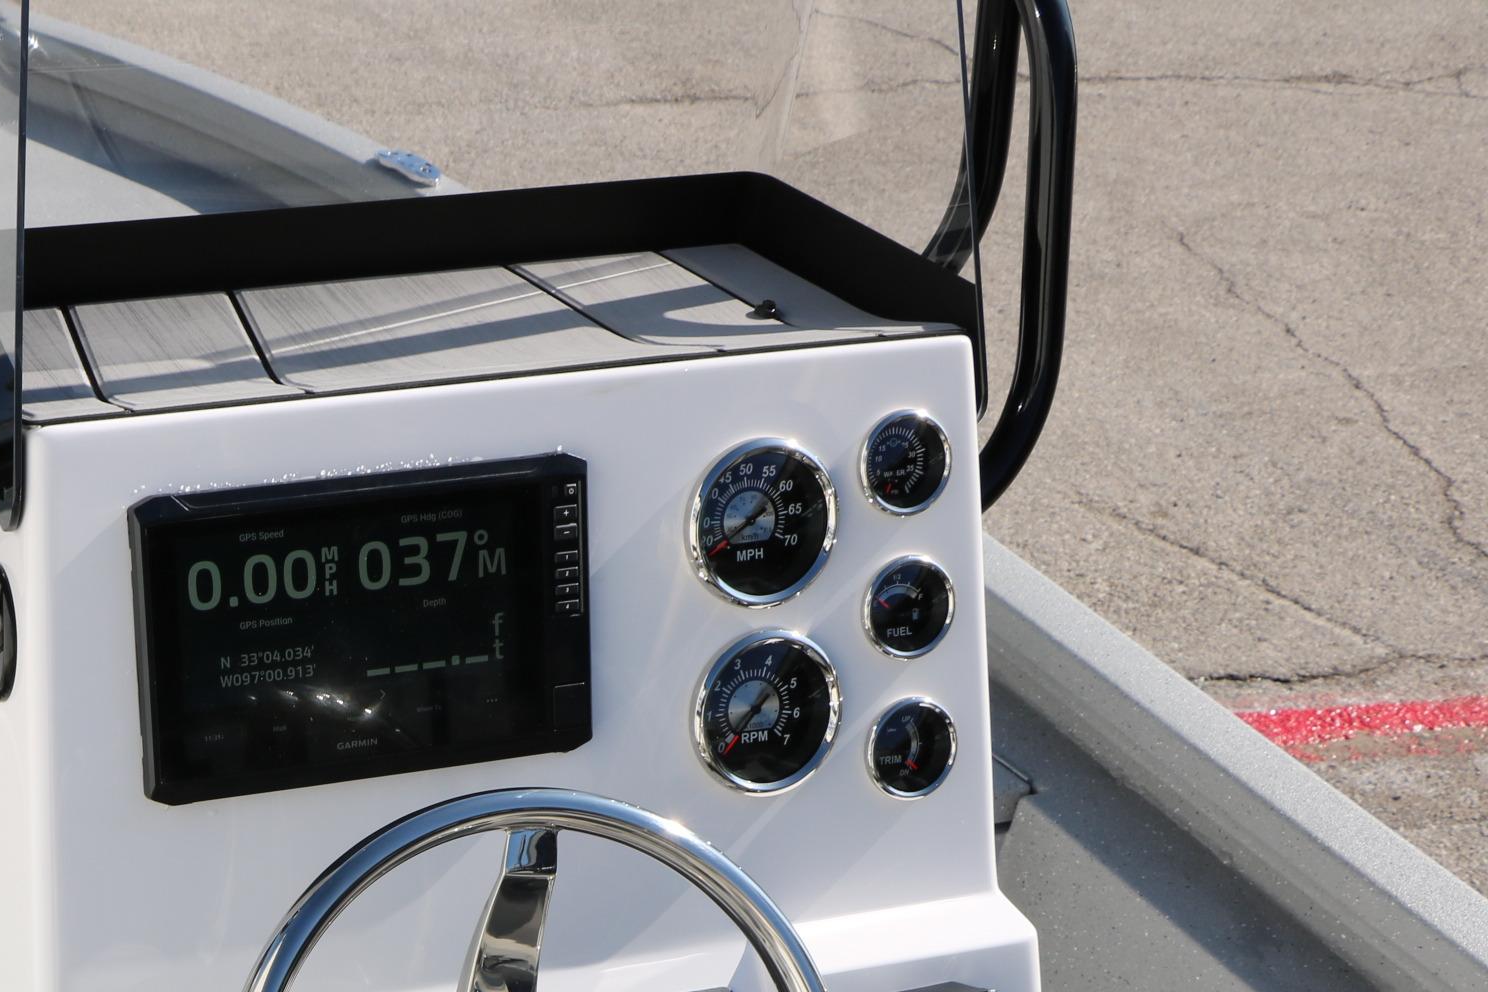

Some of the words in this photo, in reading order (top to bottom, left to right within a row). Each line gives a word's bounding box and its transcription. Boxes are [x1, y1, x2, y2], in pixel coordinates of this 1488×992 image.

[739, 463, 753, 475] 50
[762, 465, 776, 477] 55
[779, 480, 793, 492] 60
[788, 503, 802, 515] 65
[401, 513, 417, 523] GPS
[239, 532, 257, 543] GPS
[259, 529, 284, 543] Speed
[784, 534, 798, 546] 70
[737, 547, 764, 562] MPH
[187, 549, 317, 612] 0.00
[423, 597, 447, 609] Depth
[239, 620, 257, 630] GPS
[259, 616, 293, 629] Position
[886, 626, 913, 638] FUEL
[220, 656, 231, 669] N
[734, 658, 741, 670] 3
[765, 654, 773, 666] 4
[714, 680, 721, 691] 2
[789, 677, 797, 688] 5
[793, 707, 800, 718] 6
[741, 731, 768, 744] RPM
[783, 734, 790, 745] 7
[337, 738, 378, 751] GARMIN
[718, 742, 725, 753] 0
[880, 755, 902, 765] TRIM
